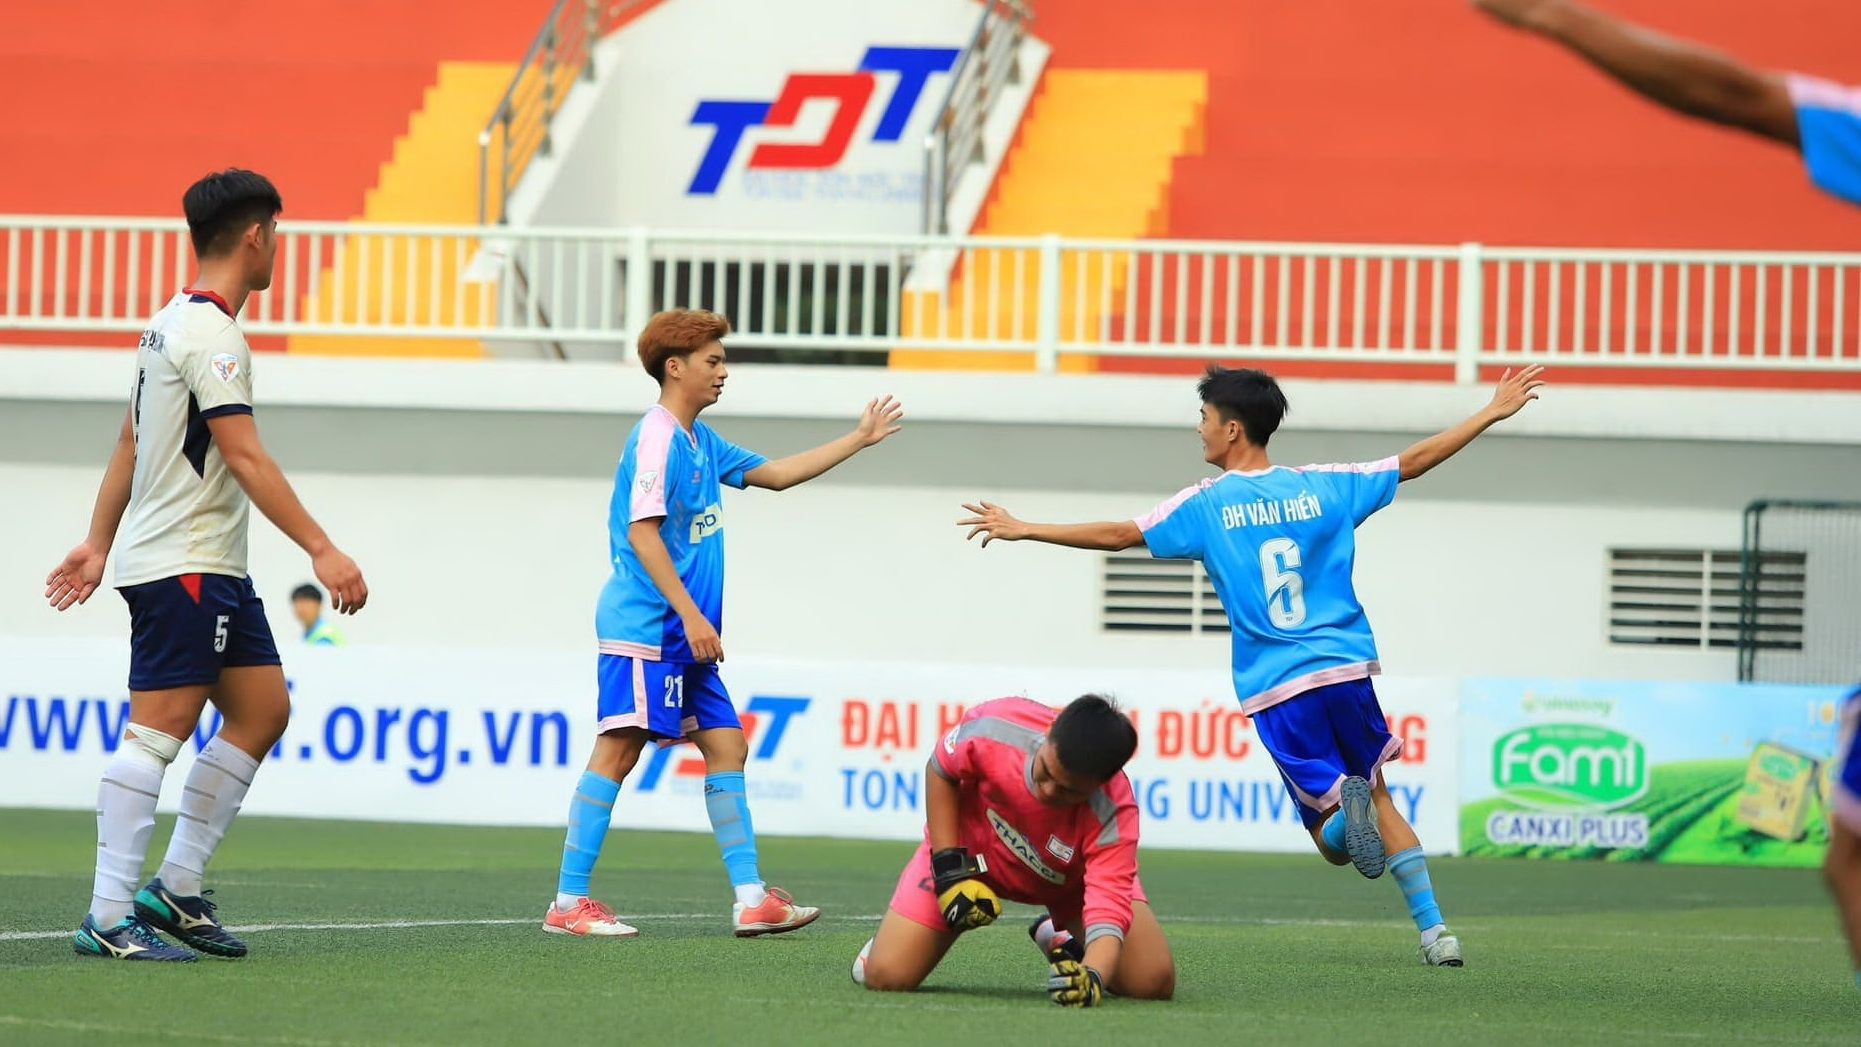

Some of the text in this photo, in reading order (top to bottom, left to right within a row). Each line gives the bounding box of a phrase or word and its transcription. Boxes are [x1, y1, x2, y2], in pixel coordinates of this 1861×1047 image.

[1222, 503, 1247, 530] ĐH
[1246, 497, 1282, 526] VĂN
[1259, 536, 1307, 630] 6
[213, 615, 230, 653] 5
[664, 675, 684, 708] 21
[842, 700, 919, 762] ĐẠI
[1156, 698, 1250, 760] ĐỨC
[1490, 814, 1645, 844] CANXI PLUS
